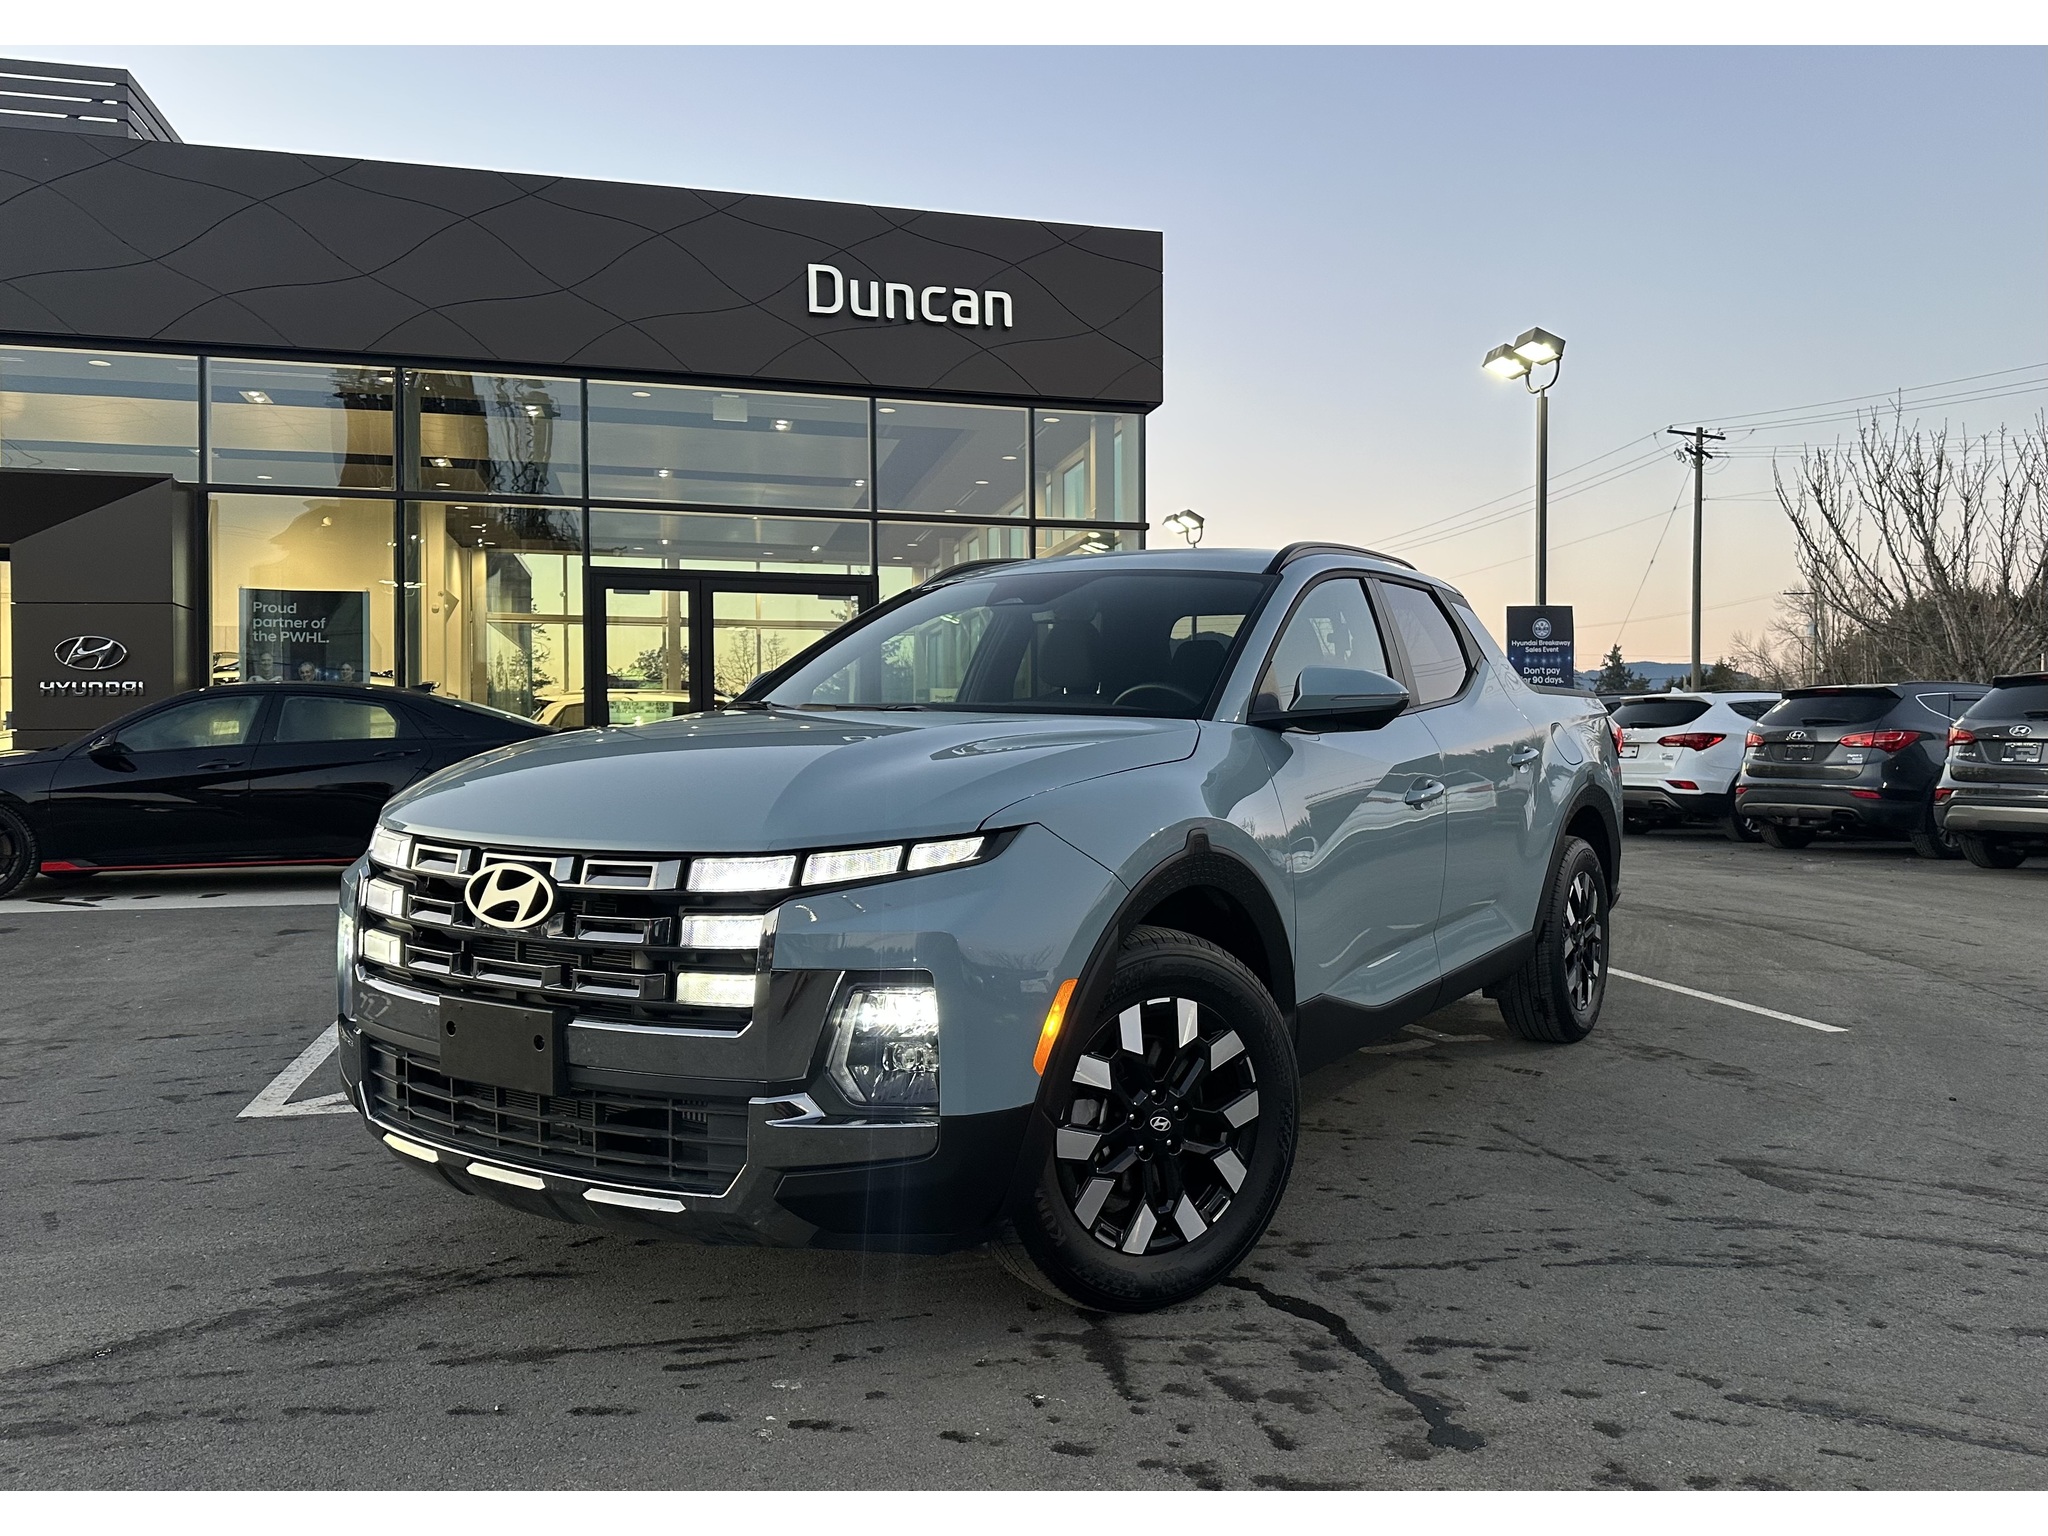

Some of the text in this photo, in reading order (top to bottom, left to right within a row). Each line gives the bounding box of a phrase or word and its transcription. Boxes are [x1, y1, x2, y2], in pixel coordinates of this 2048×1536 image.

[807, 263, 1013, 328] Duncan
[252, 601, 297, 614] Proud
[252, 617, 327, 630] partner of
[252, 630, 330, 643] the PWHL.
[1546, 667, 1560, 675] pay
[1532, 675, 1543, 684] 90
[39, 681, 144, 697] HYUNDAI
